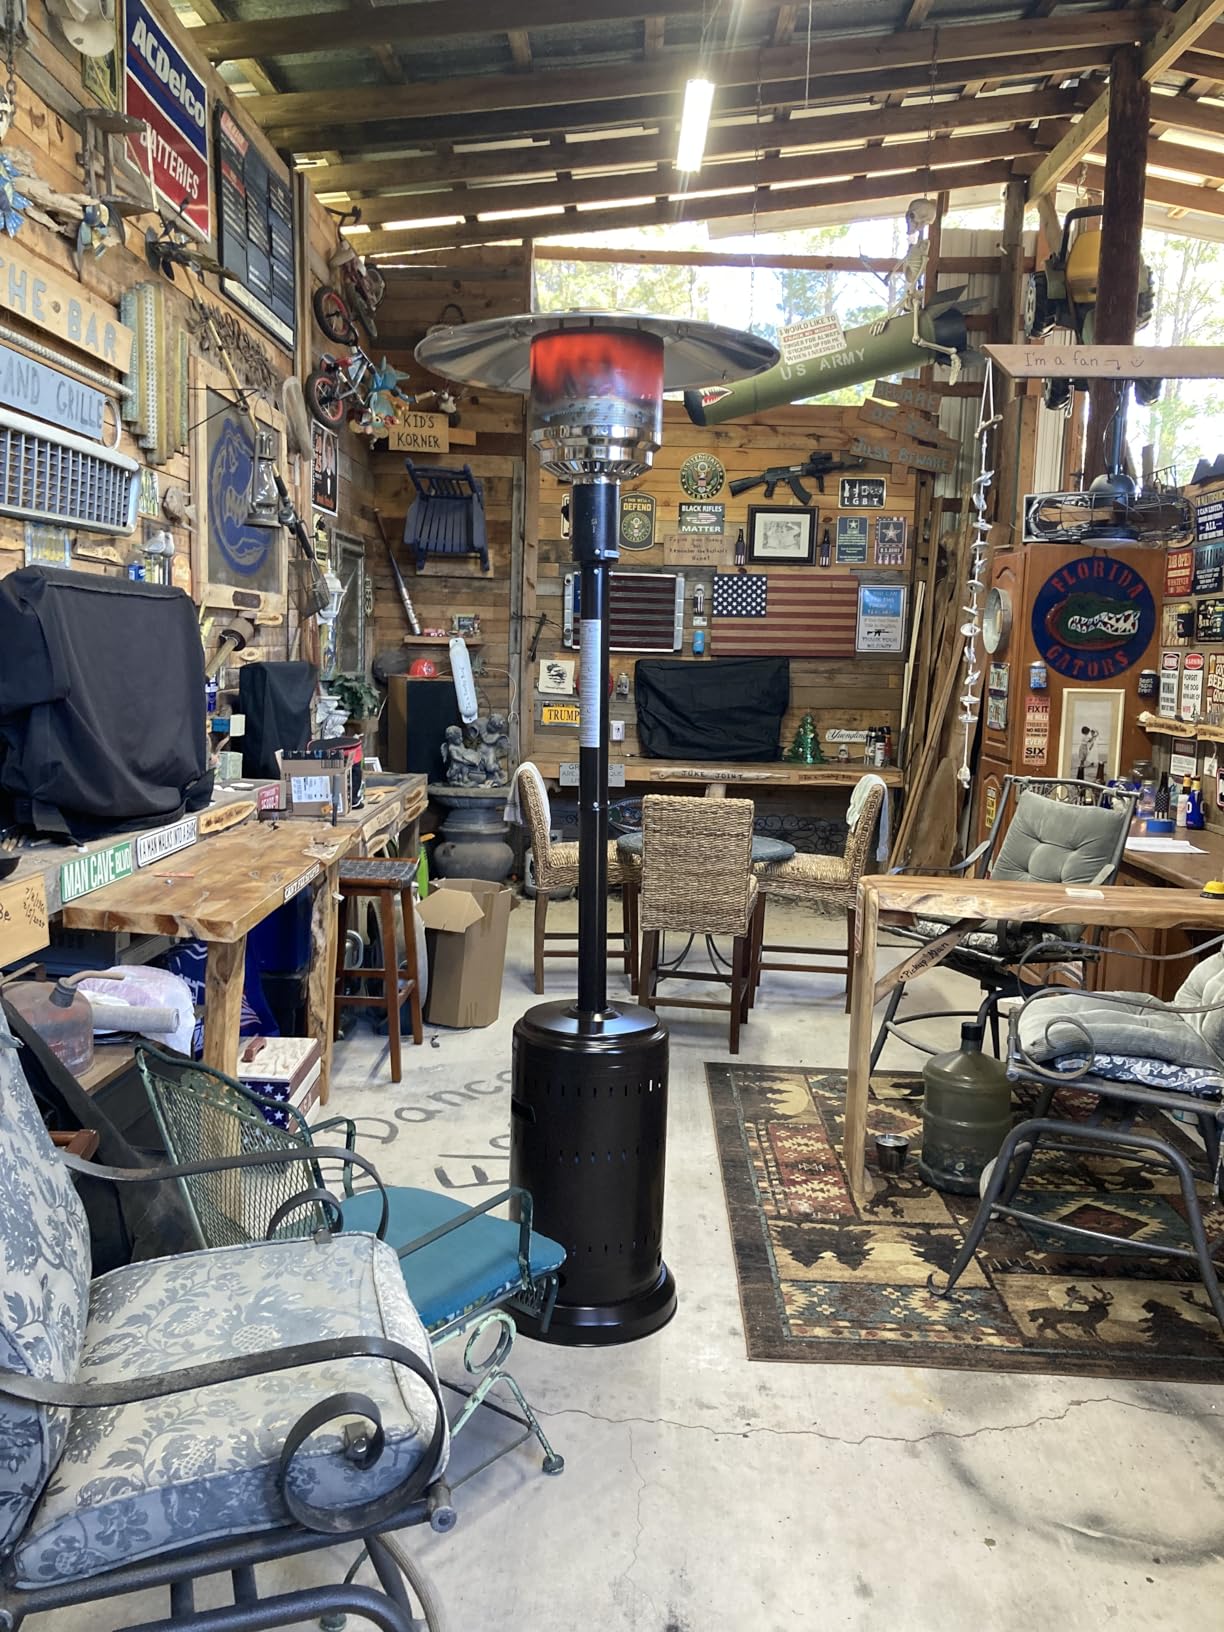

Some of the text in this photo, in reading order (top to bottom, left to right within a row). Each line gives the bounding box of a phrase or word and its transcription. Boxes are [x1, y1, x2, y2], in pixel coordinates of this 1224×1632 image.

[132, 17, 205, 128] ACDelco
[140, 119, 199, 200] BATTERIES
[0, 257, 116, 361] HE BAR
[784, 323, 808, 334] WOULD
[810, 318, 824, 327] LIKE
[826, 315, 836, 323] TO
[780, 348, 865, 381] US ARMY
[1024, 350, 1099, 367] I'm a fan
[3, 356, 40, 405] AND
[403, 413, 435, 429] KID'S
[397, 432, 440, 449] KORNER
[623, 503, 652, 511] DEFEND
[681, 525, 721, 533] MATTER
[1205, 521, 1216, 531] ALL
[1051, 560, 1144, 599] FLORIDA
[1046, 644, 1129, 678] GATORS
[1184, 674, 1198, 682] FORGET
[547, 709, 580, 721] TRUMP
[828, 730, 867, 741] Yuengling
[1025, 747, 1045, 755] SIX
[147, 835, 157, 857] MAN
[158, 830, 172, 852] WALKS
[63, 847, 131, 899] MAN CAVE BLVD
[902, 942, 950, 978] Pickup Man
